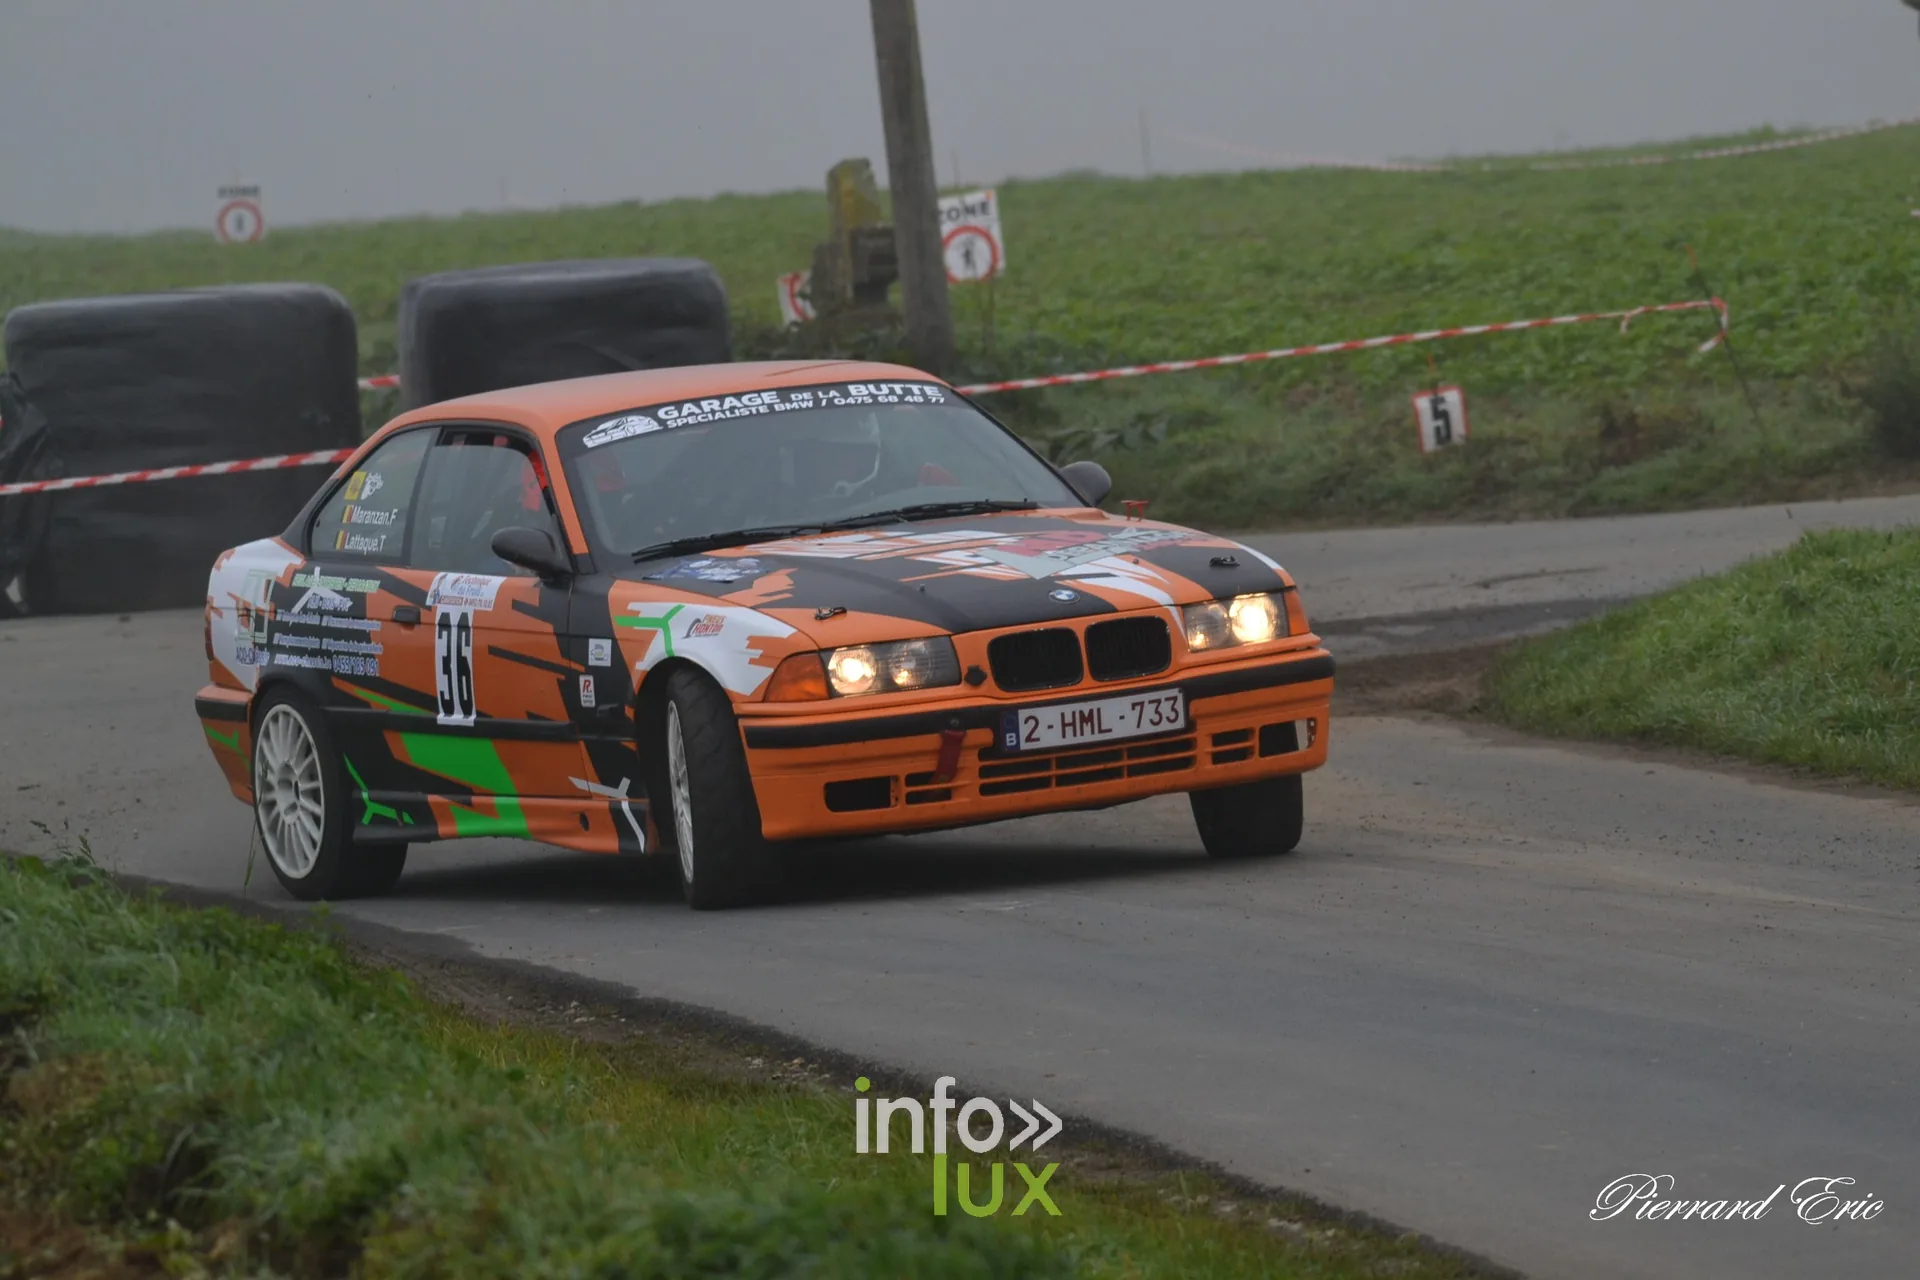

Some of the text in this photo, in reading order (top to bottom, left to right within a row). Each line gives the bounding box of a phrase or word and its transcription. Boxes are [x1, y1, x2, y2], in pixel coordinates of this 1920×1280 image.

[657, 384, 943, 420] GARAGE DE LA BUTTE
[666, 405, 770, 429] SPECIALISTE
[773, 400, 814, 412] BMW
[833, 396, 873, 406] 0475
[1430, 396, 1452, 445] 5
[437, 611, 474, 718] 36
[1005, 732, 1017, 747] B
